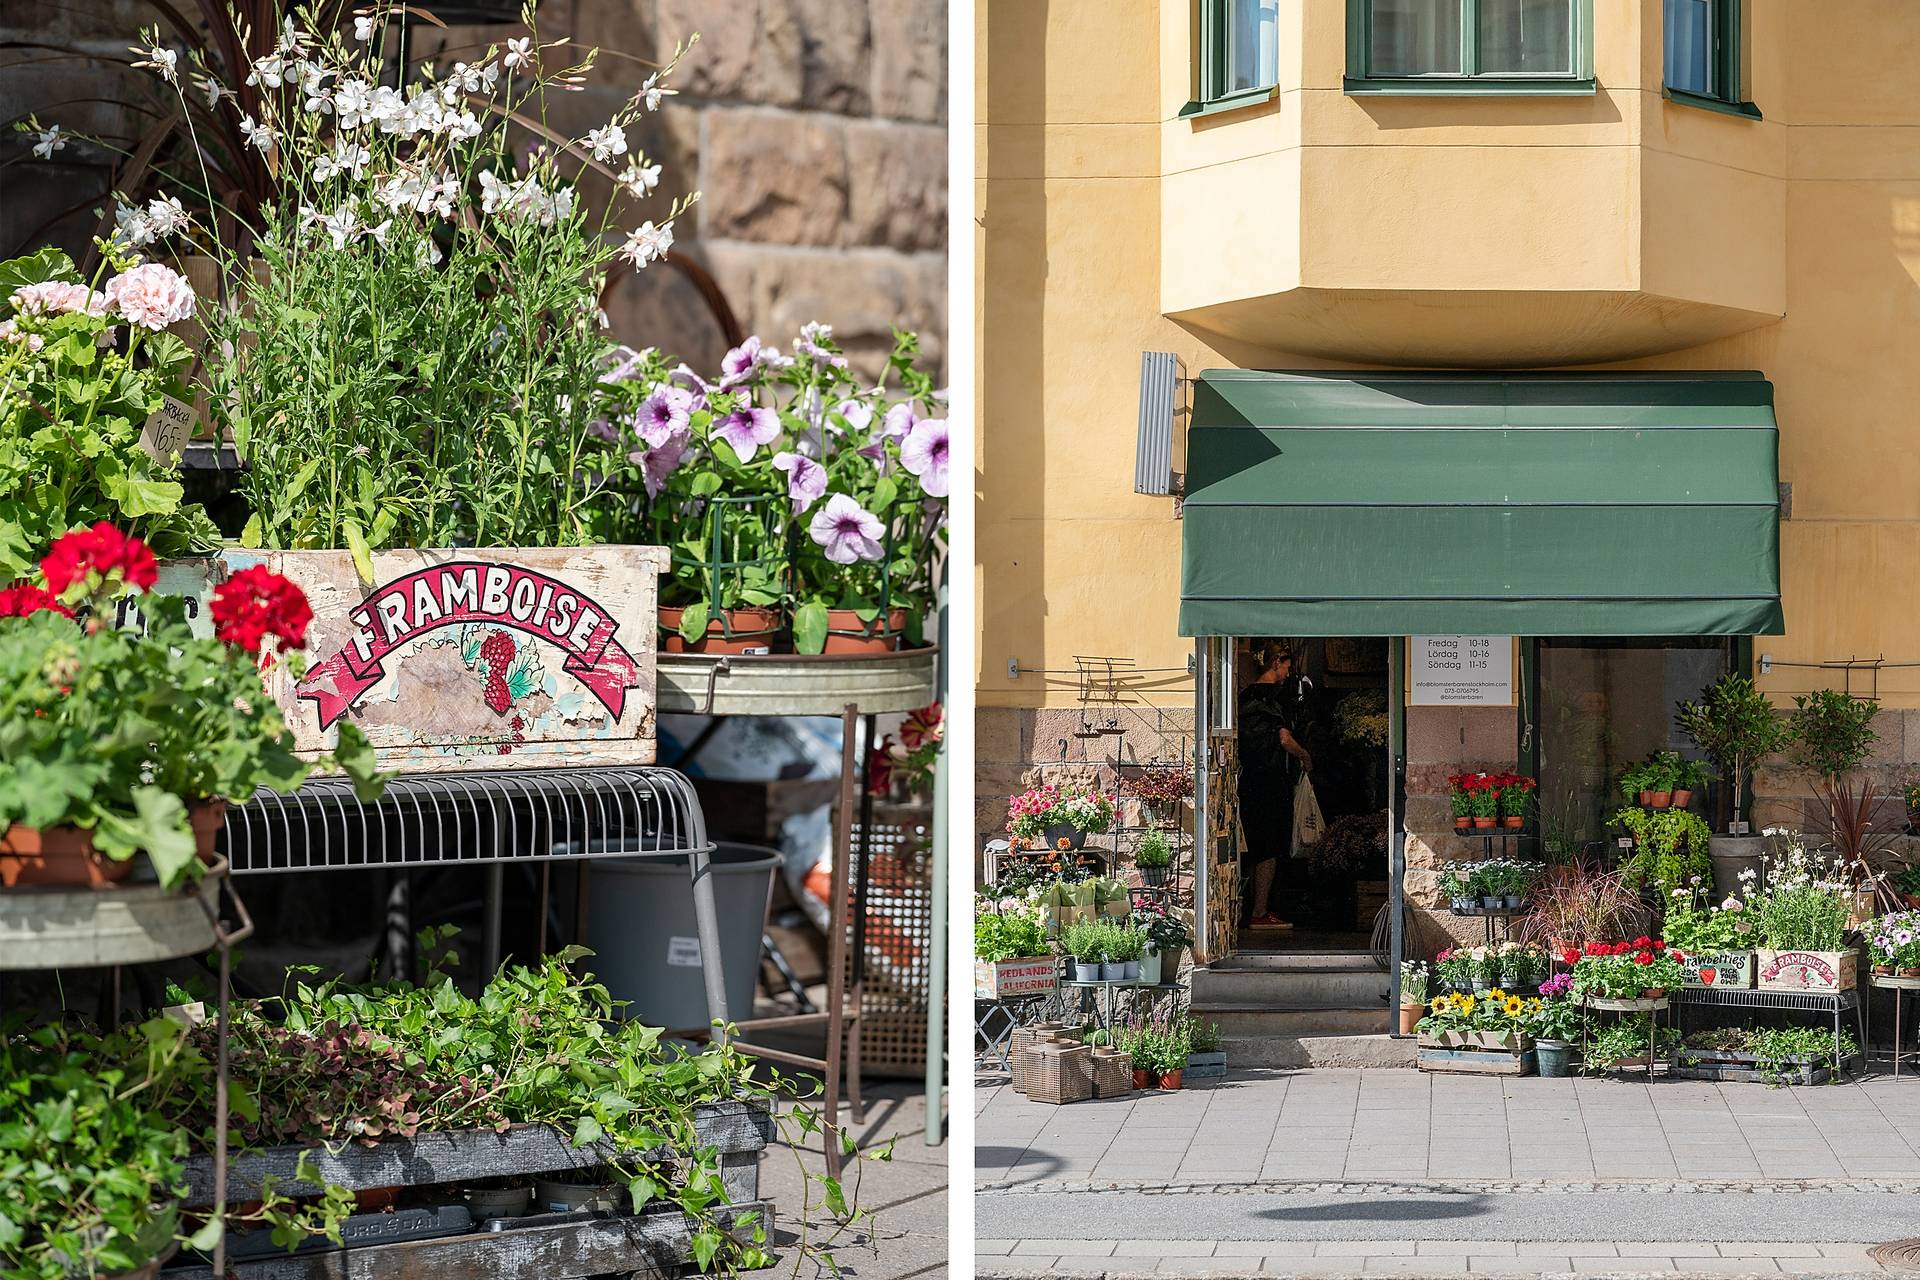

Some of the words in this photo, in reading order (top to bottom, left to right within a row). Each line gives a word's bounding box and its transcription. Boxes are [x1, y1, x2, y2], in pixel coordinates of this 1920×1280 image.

[162, 398, 191, 425] ÅRBACKA
[350, 567, 602, 662] FRAMBOISE
[1428, 639, 1458, 649] Fredag
[1469, 639, 1490, 648] 10-18
[1428, 650, 1458, 660] Lördag
[1469, 650, 1490, 658] 10-16
[1428, 661, 1461, 671] Söndag
[1469, 661, 1488, 669] 11-15
[1772, 954, 1829, 971] FRAMBOISE
[999, 966, 1053, 978] REDLANDS
[1003, 978, 1056, 991] ALIFORNIA
